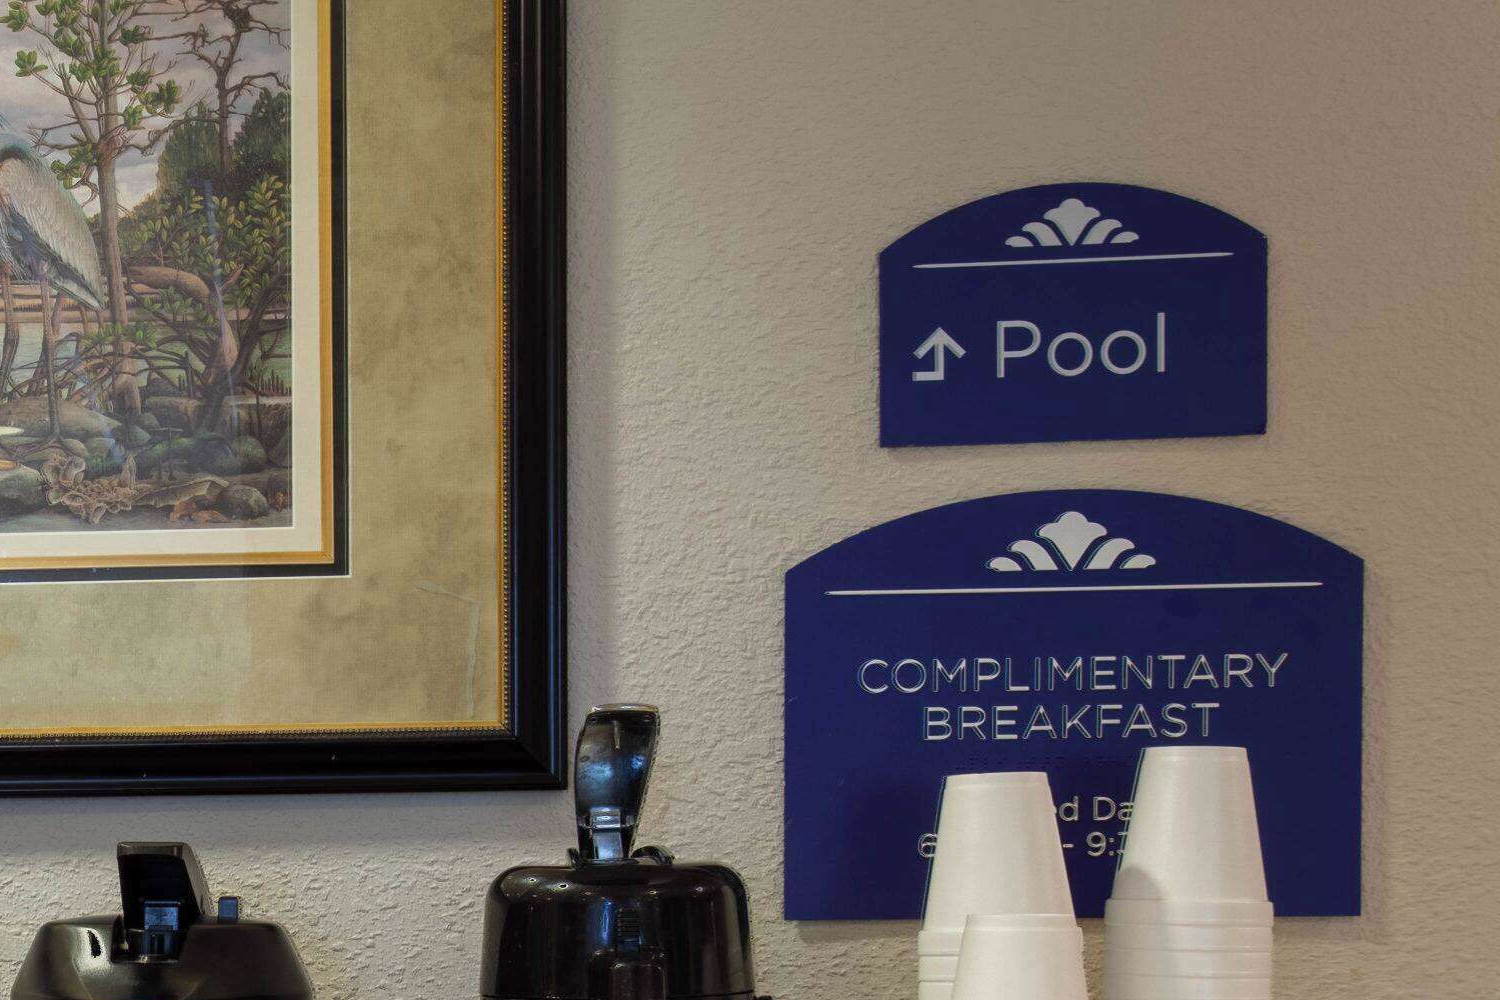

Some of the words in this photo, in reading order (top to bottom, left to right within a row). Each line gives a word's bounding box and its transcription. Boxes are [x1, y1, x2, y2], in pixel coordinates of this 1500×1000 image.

[995, 312, 1167, 378] Pool
[857, 652, 1289, 694] COMPLIMENTARY
[922, 702, 1220, 741] BREAKFAST
